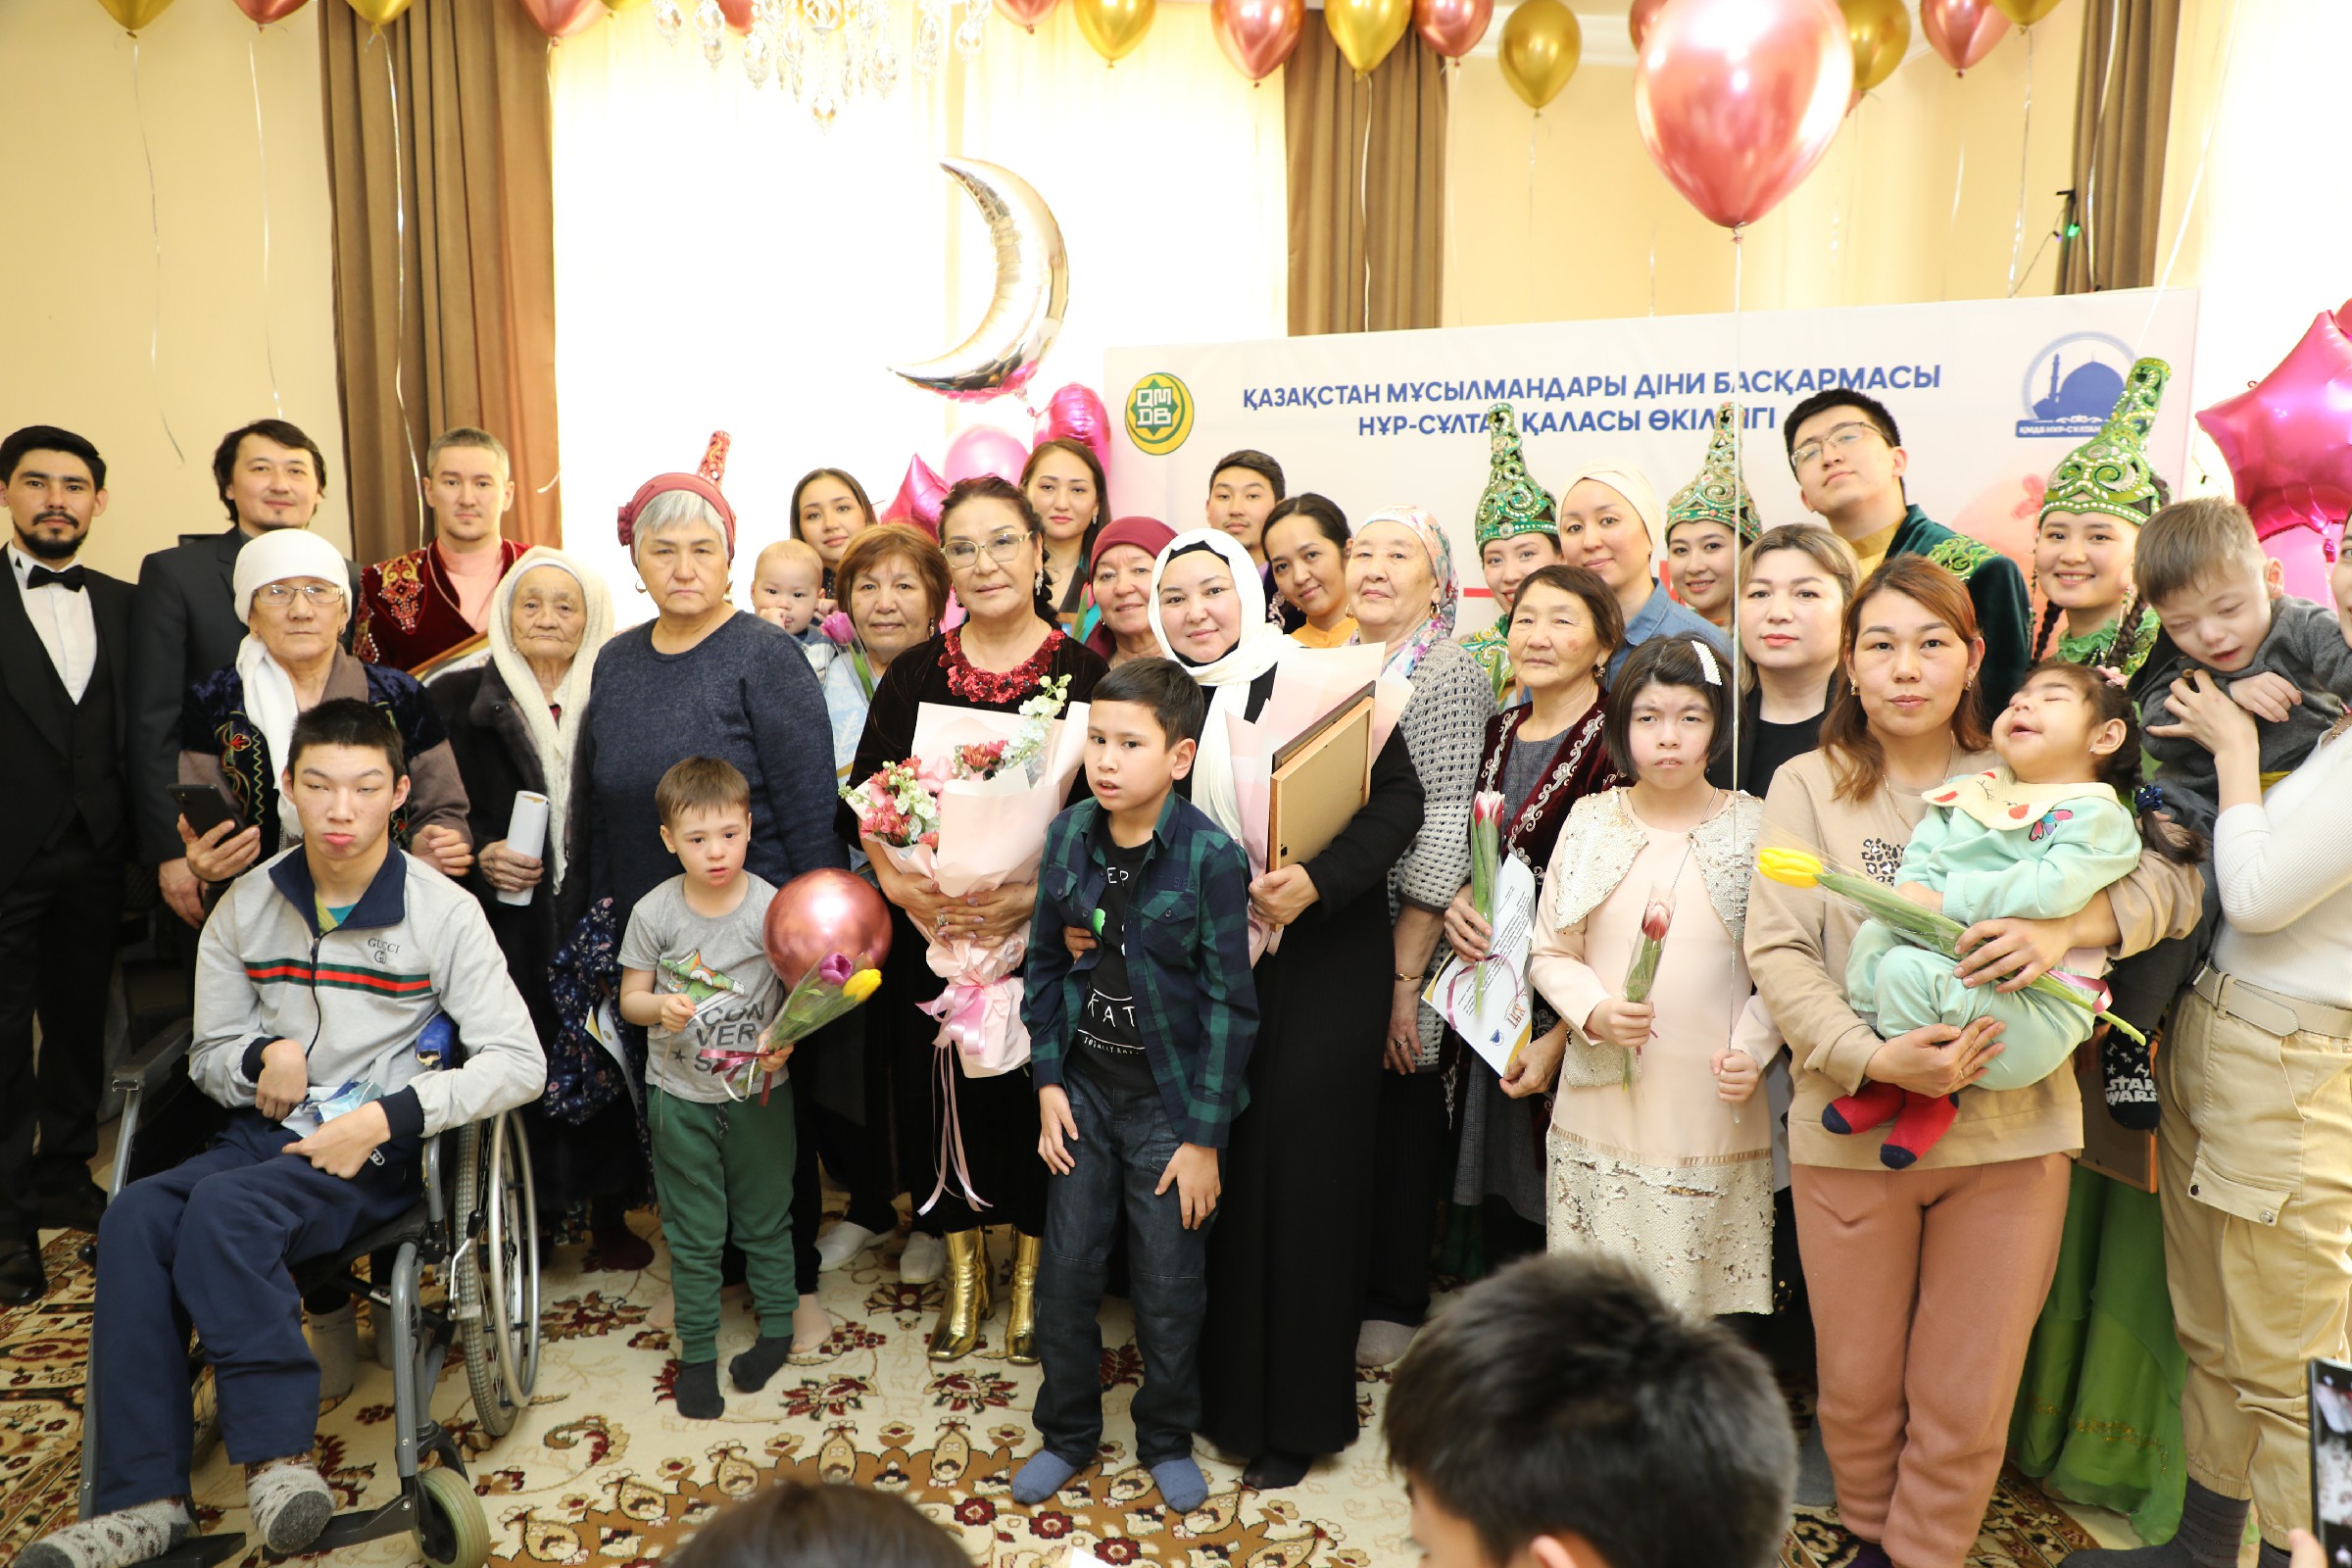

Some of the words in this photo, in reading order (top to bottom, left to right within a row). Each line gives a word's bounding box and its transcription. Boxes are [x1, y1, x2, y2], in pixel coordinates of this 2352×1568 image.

[1243, 383, 1381, 411] ҚАЗАҚСТАН
[1387, 374, 1627, 403] МҰСЫЛМАНДАРЫ
[1634, 372, 1706, 400] ДІНИ
[1713, 365, 1941, 396] БАСҚАРМАСЫ
[1358, 414, 1491, 436] НҰР-СҰЛТА
[1522, 410, 1641, 436] ҚАЛАСЫ
[1648, 407, 1776, 431] ӨКІЛІГІ
[368, 938, 401, 954] GUCCI
[701, 1003, 764, 1026] CON
[696, 1022, 757, 1047] VER
[2105, 1075, 2156, 1092] STAR
[2106, 1090, 2158, 1104] WARS
